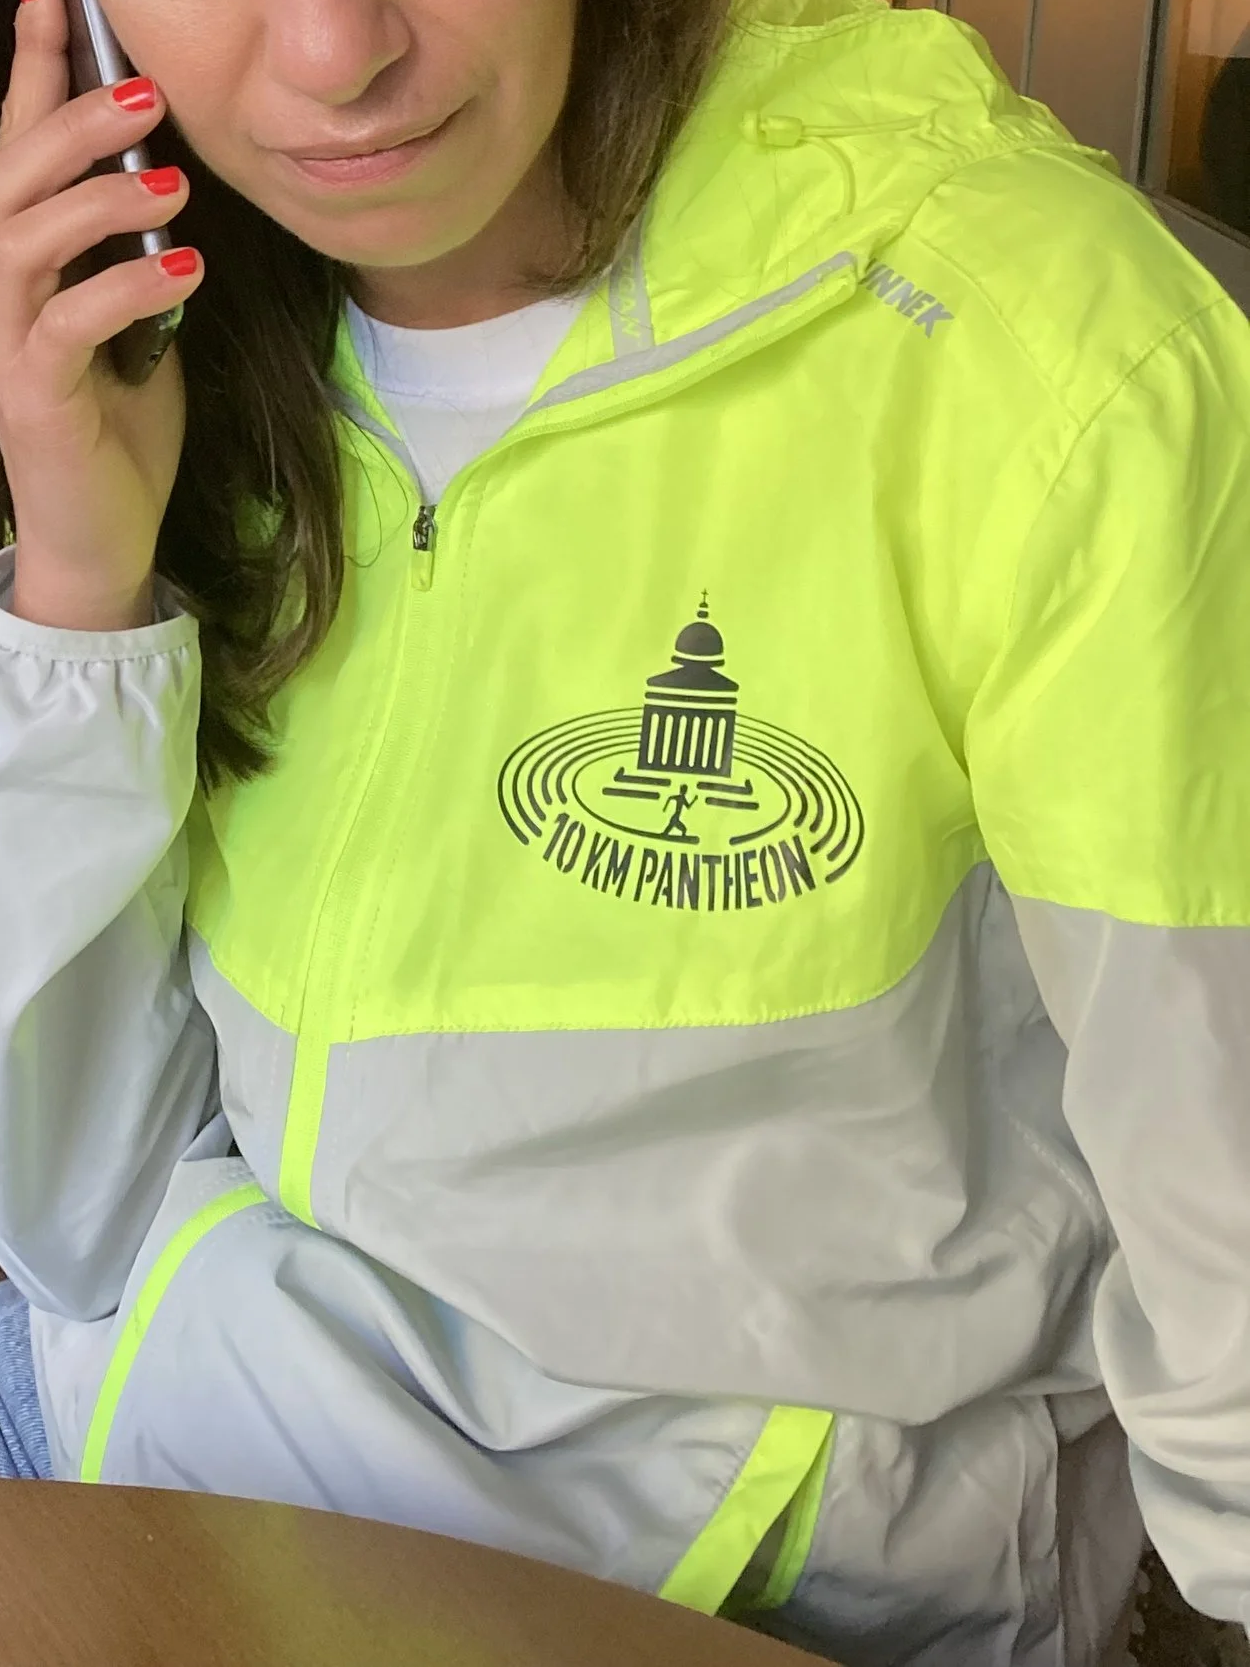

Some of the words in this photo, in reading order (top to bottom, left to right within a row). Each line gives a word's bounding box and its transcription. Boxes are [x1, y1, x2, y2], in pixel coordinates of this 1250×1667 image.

[543, 812, 586, 874] 10
[580, 832, 635, 898] KM
[634, 835, 816, 912] PANTHEON
